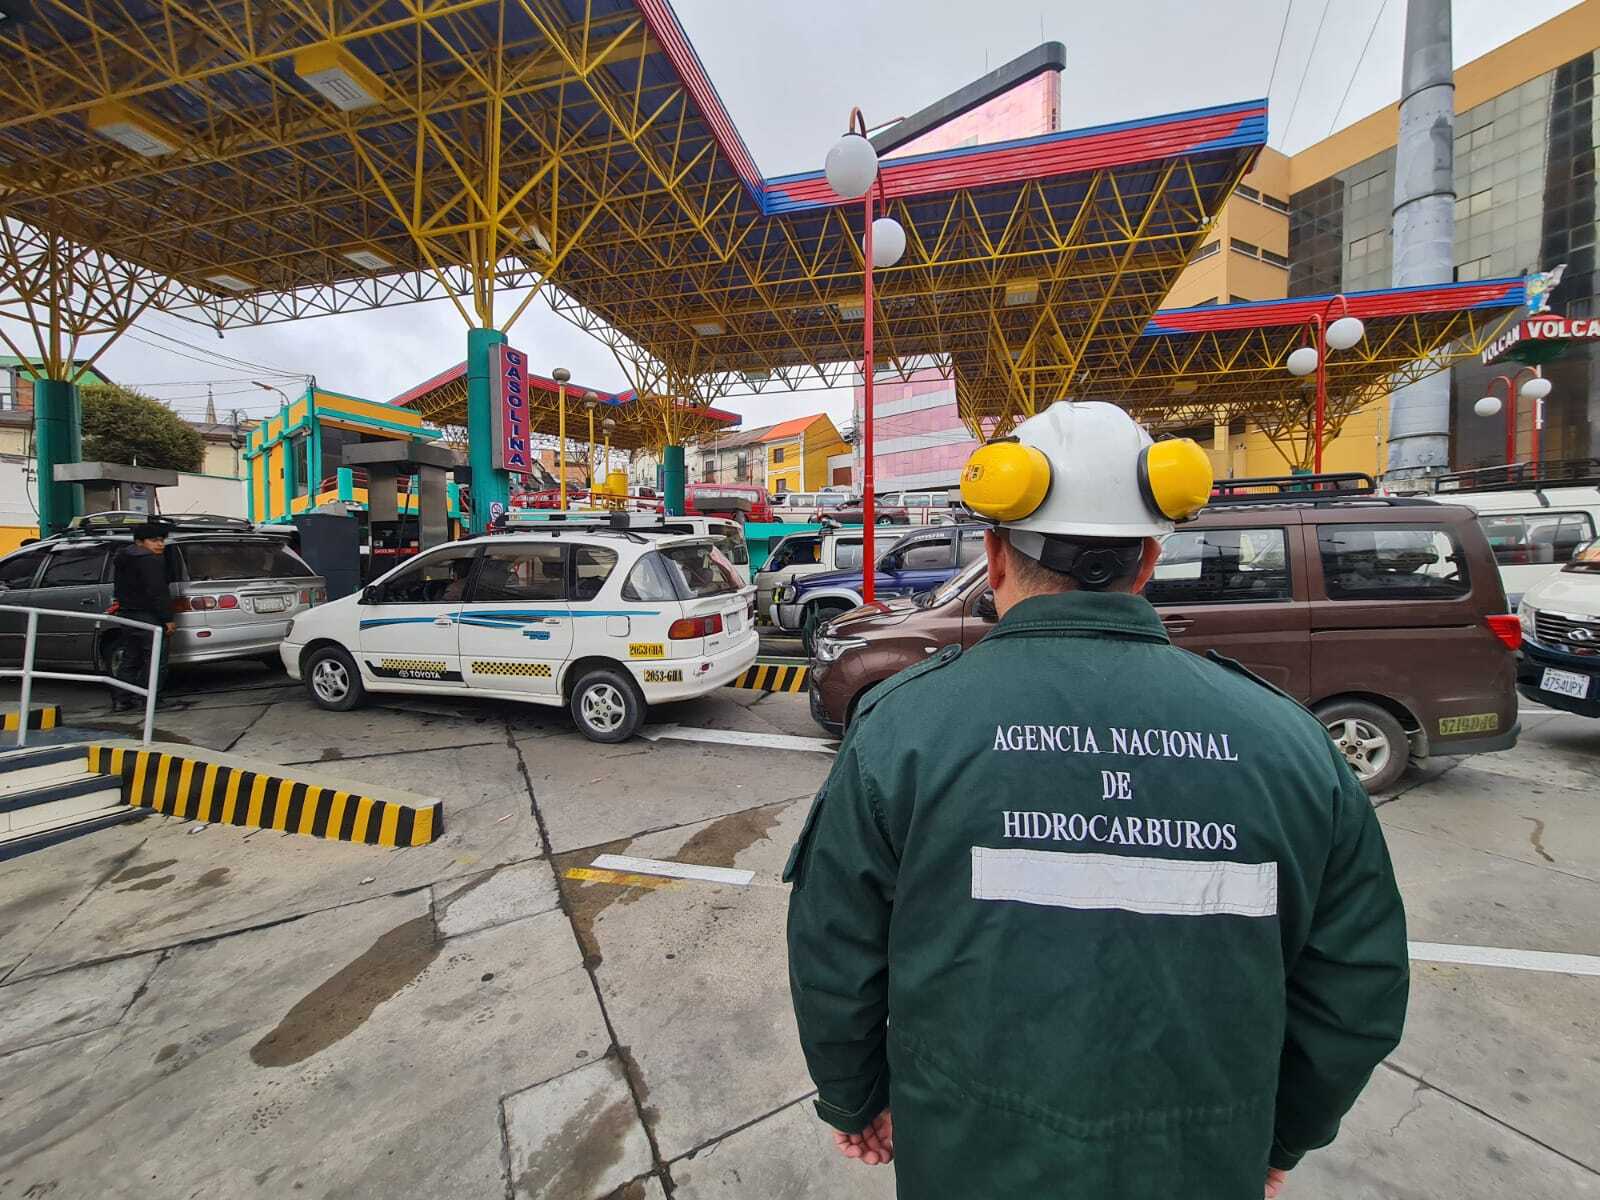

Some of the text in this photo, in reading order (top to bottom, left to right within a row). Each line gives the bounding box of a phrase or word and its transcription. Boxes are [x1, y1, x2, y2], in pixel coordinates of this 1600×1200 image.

[1481, 325, 1520, 364] VOLCAN
[505, 351, 526, 467] GASOLINA
[410, 671, 441, 679] TOYOTA
[993, 725, 1239, 762] AGENCIA NACIONAL
[1101, 771, 1132, 801] DE
[1002, 811, 1238, 850] HIDROCARBUROS
